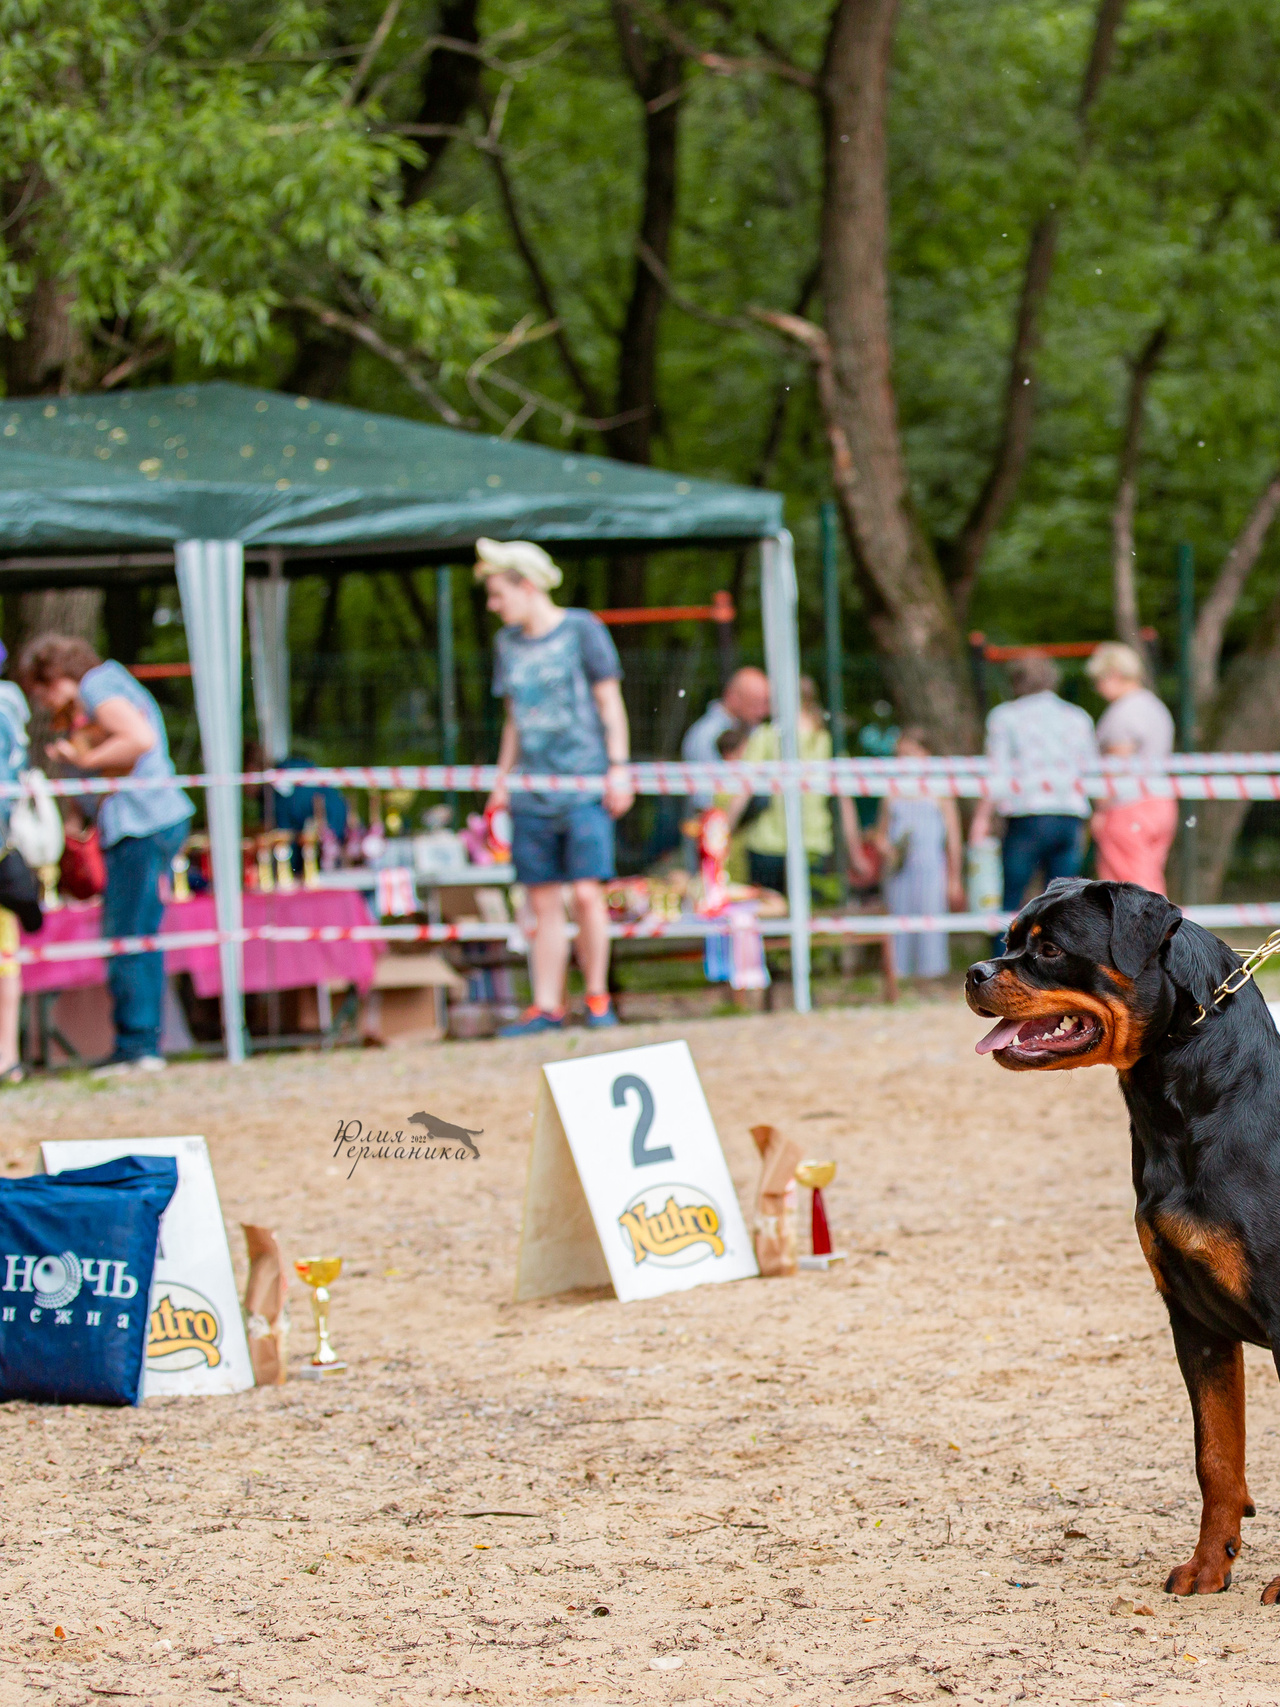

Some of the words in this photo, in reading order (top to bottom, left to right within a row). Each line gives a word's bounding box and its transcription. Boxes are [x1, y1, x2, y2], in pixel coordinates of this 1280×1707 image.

[611, 1073, 675, 1168] 2
[618, 1196, 725, 1266] Nutro
[2, 1306, 130, 1330] нежна
